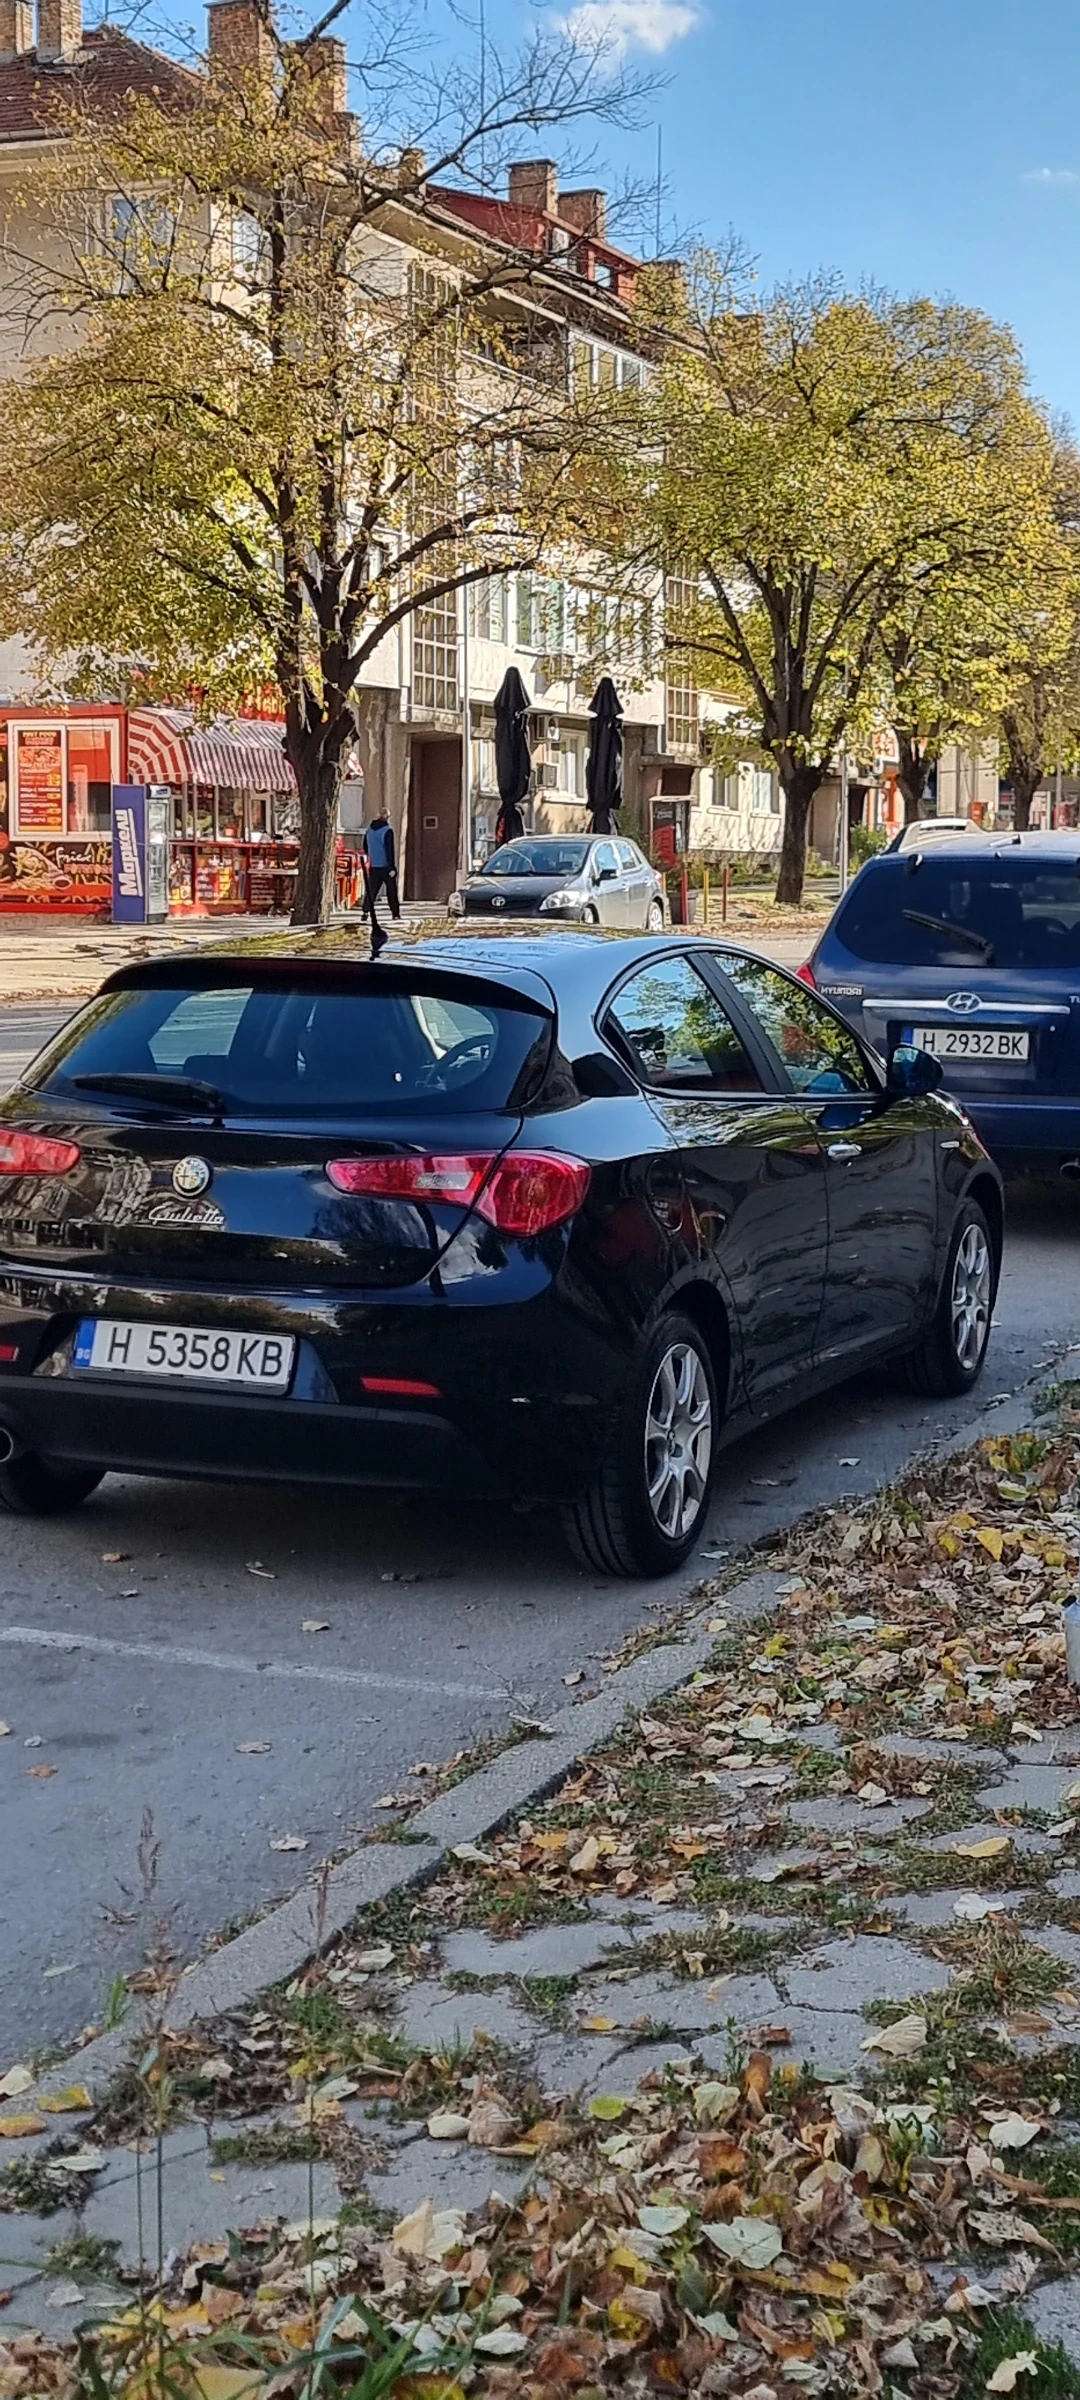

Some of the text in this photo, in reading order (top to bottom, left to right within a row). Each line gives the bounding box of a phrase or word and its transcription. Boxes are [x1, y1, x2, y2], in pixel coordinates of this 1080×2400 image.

[115, 808, 141, 896] Маркели
[820, 986, 863, 996] HYUNDAI
[148, 1205, 225, 1226] Giulietta
[107, 1327, 133, 1364] H
